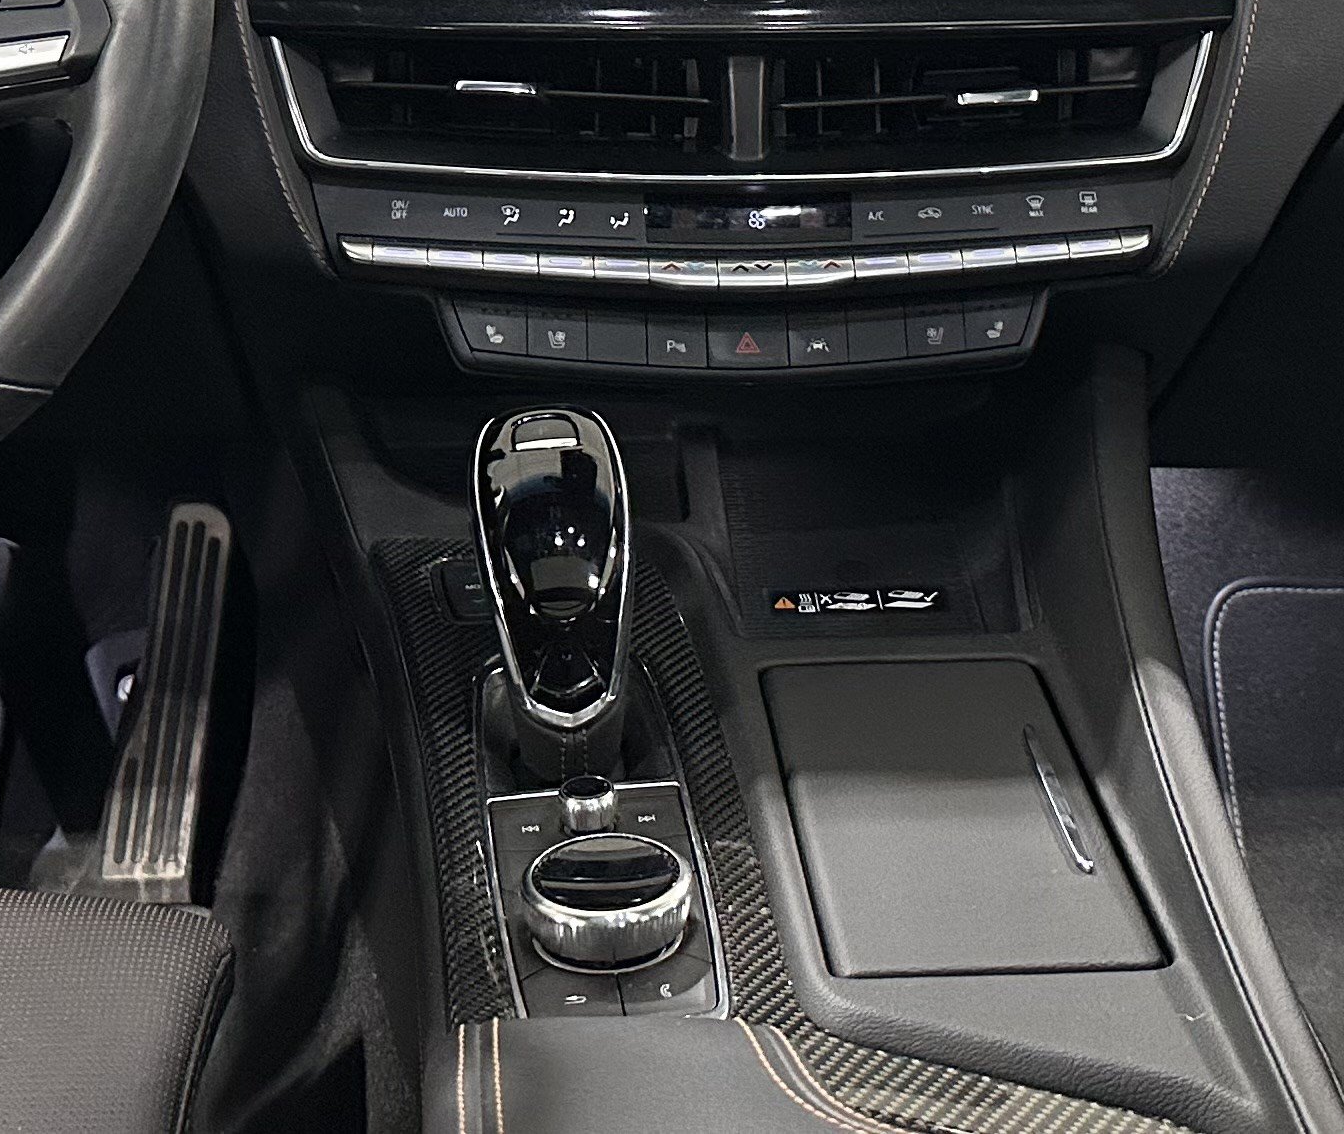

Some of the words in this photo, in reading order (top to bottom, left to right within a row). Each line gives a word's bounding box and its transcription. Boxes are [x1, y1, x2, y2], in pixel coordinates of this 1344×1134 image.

[391, 199, 410, 210] ON/
[971, 204, 995, 216] SYNC
[391, 209, 408, 220] OFF
[443, 207, 468, 218] AUTO
[868, 210, 885, 222] A/C
